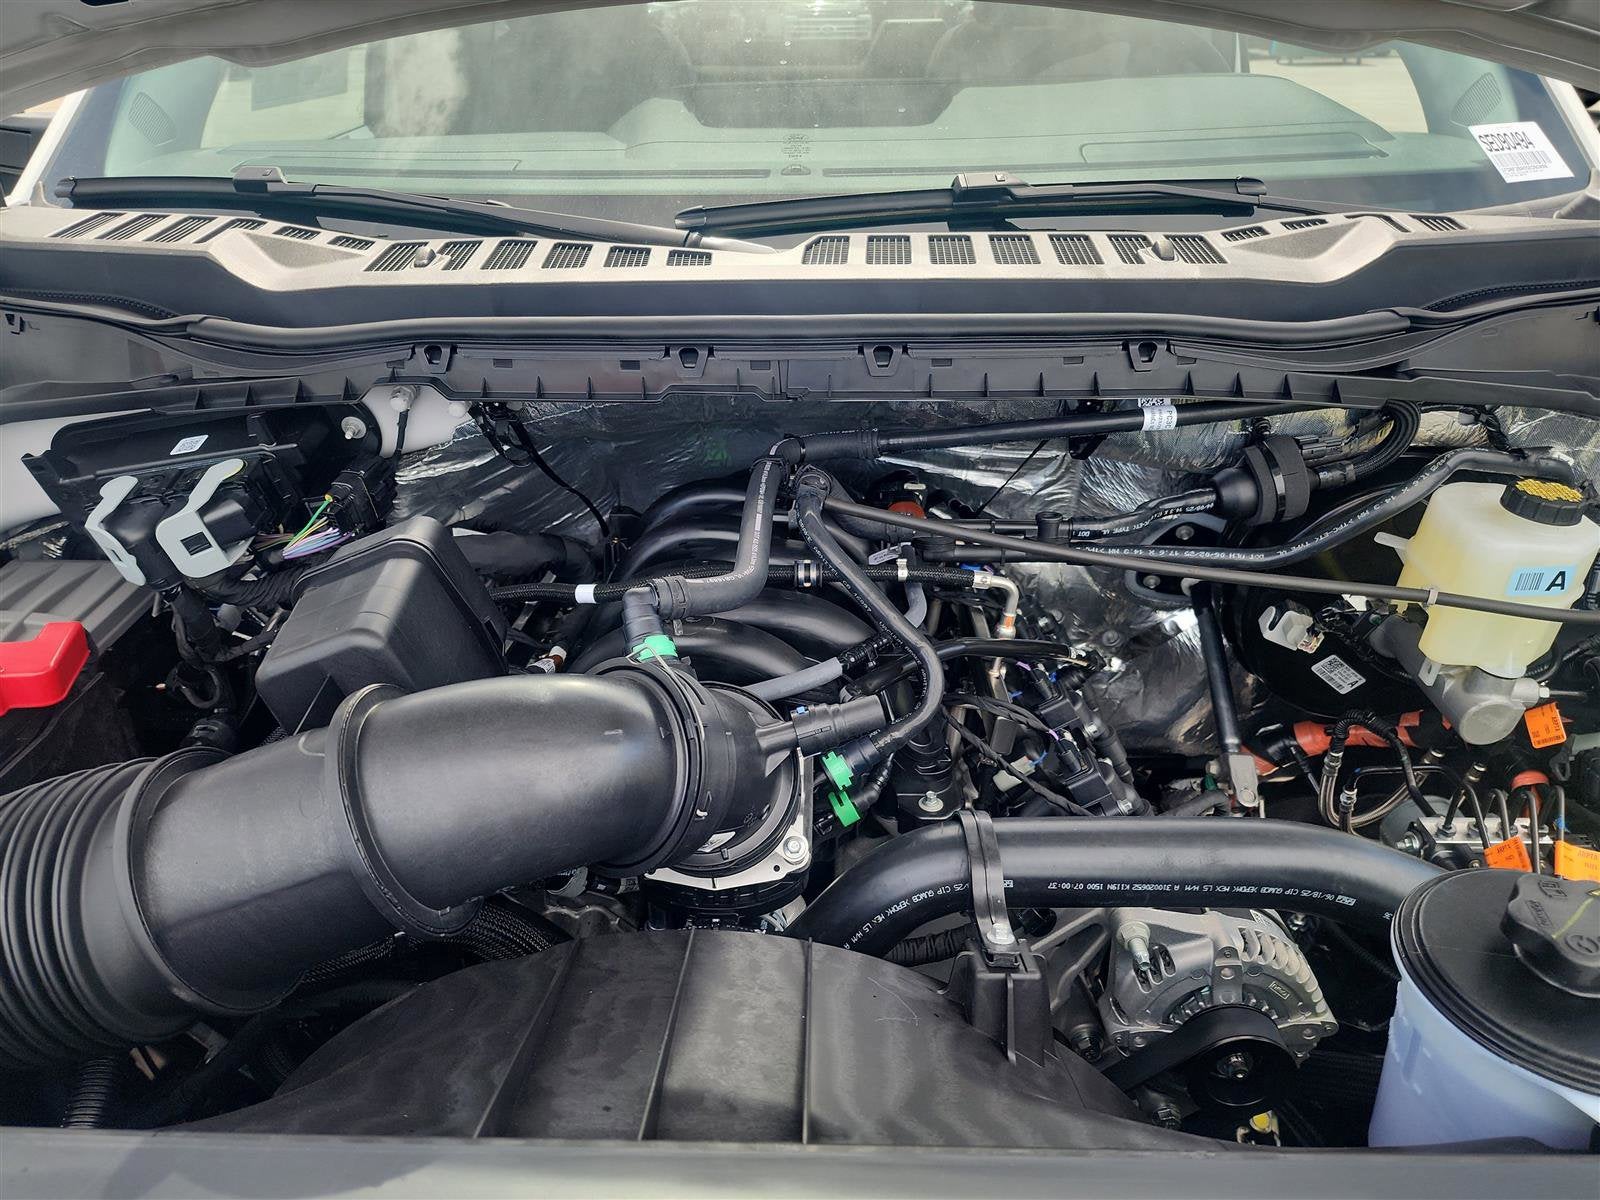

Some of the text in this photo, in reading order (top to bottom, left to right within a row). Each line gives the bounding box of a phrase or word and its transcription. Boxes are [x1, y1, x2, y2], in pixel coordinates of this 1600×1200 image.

[1478, 131, 1536, 152] SED90494
[1546, 571, 1566, 592] A
[937, 885, 951, 895] CIP
[1132, 883, 1171, 891] 310020652
[1284, 887, 1300, 896] CIP
[862, 922, 873, 933] LS
